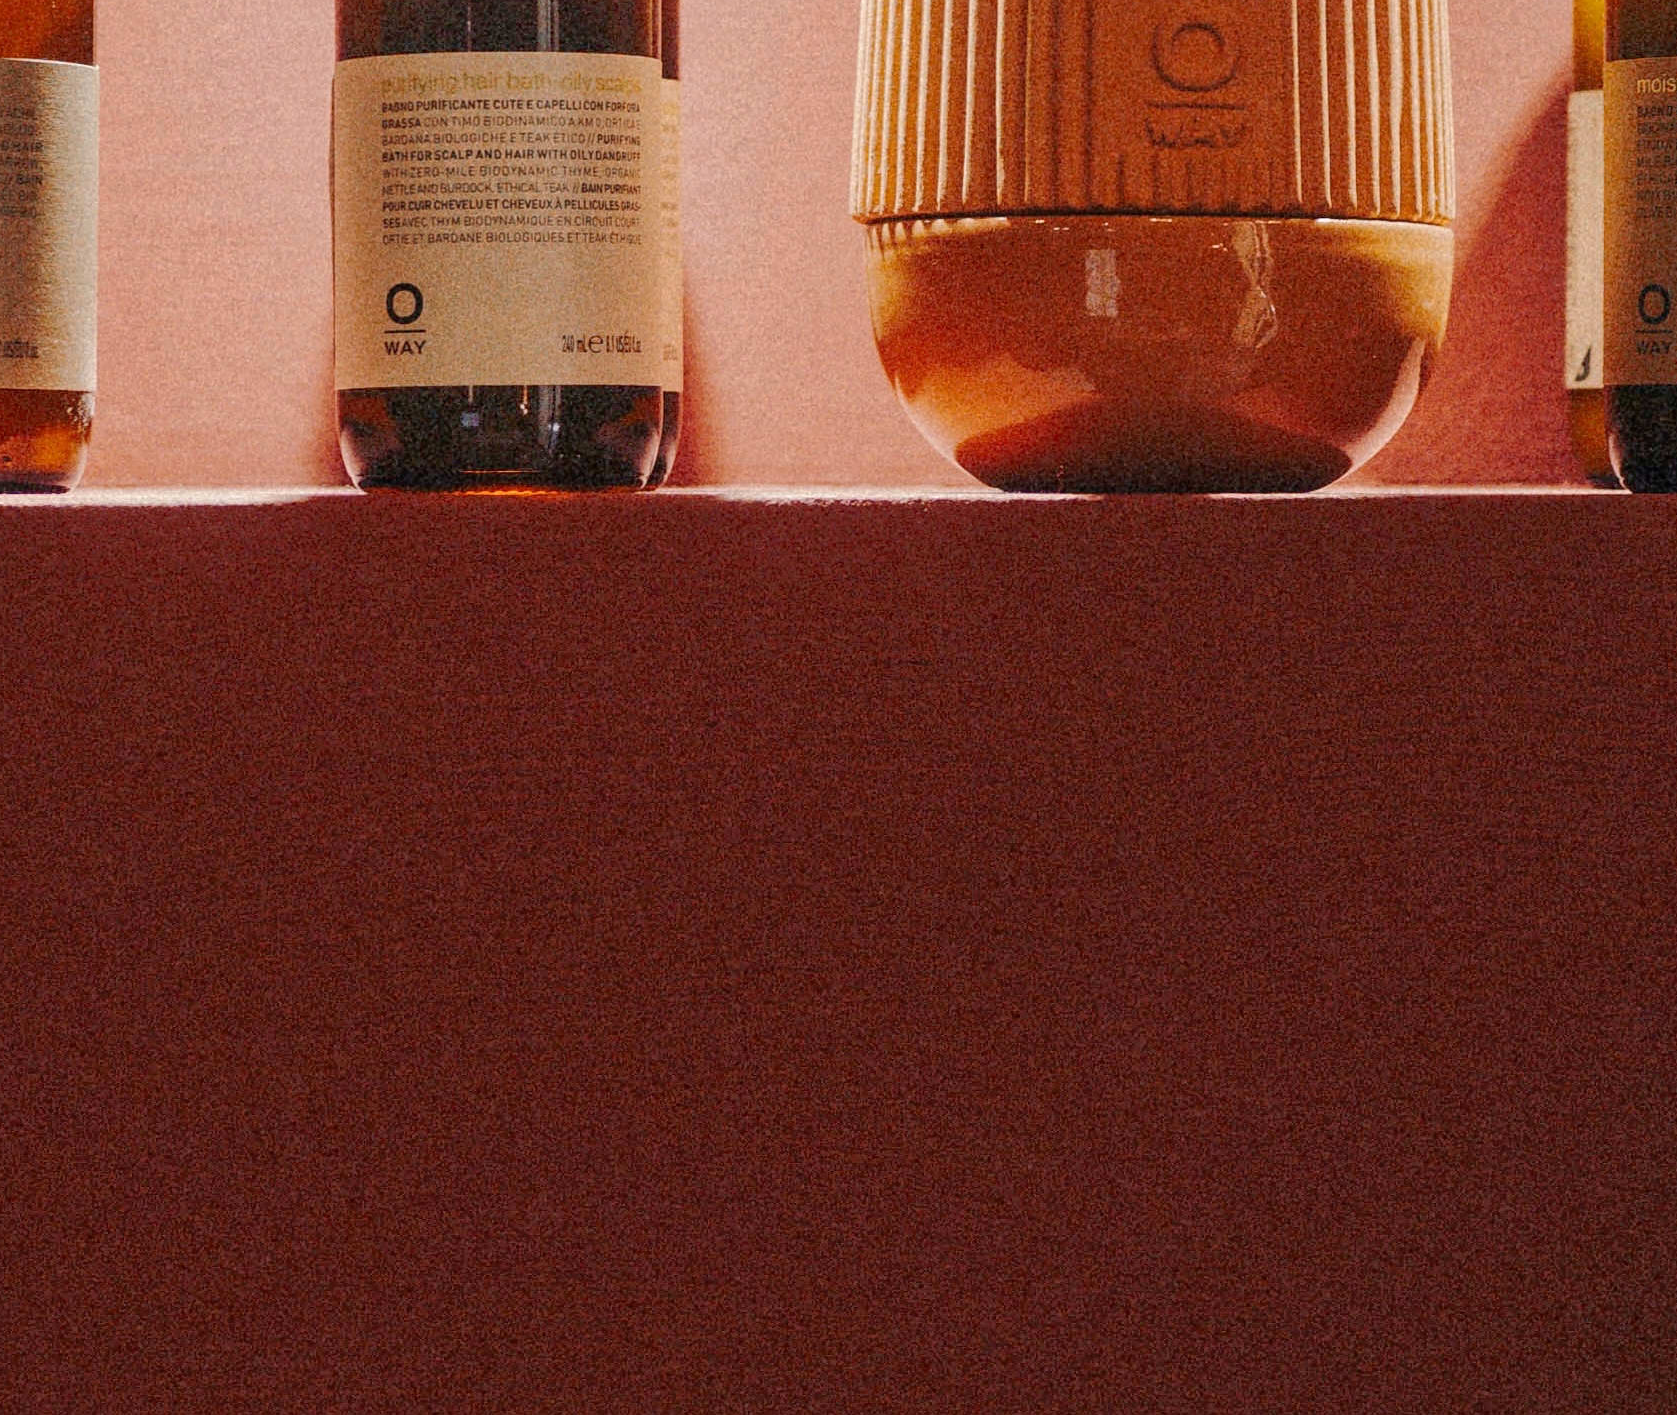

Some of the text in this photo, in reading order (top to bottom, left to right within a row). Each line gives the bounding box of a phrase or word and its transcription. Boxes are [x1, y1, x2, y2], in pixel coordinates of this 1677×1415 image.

[416, 100, 491, 111] PURIFICANTE
[493, 100, 523, 111] CUTE
[526, 100, 533, 111] E
[536, 100, 582, 111] CAPELLI
[584, 100, 604, 111] CON
[382, 117, 421, 128] GRASSA
[424, 116, 448, 127] CON
[452, 116, 481, 127] TIMO
[484, 116, 565, 127] BIODINAMICO
[382, 134, 430, 146] BARDANA
[433, 133, 506, 145] BIOLOGICHE
[510, 133, 517, 145] E
[521, 133, 550, 145] TEAK
[553, 133, 586, 145] ETICO
[382, 150, 407, 162] BATH
[410, 149, 432, 161] FOR
[434, 149, 474, 161] SCALP
[476, 149, 502, 161] AND
[505, 149, 534, 161] HAIR
[537, 149, 567, 161] WITH
[570, 149, 594, 161] OILY
[479, 166, 559, 178] BIODYNAMIC
[581, 183, 603, 195] BAIN
[382, 201, 406, 211] POUR
[434, 200, 484, 210] CHEVELU
[486, 200, 499, 210] ET
[502, 200, 552, 210] CHEVEUX
[564, 199, 619, 211] PELLICULES
[431, 216, 460, 227] THYM
[463, 216, 554, 227] BIODYNAMIQUE
[557, 216, 571, 227] EN
[427, 233, 483, 244] BARDANE
[485, 233, 564, 244] BIOLOGIQUES
[567, 233, 579, 244] ET
[386, 282, 424, 325] O
[1638, 284, 1671, 325] O
[384, 339, 426, 356] WAY
[1636, 341, 1672, 355] WAY
